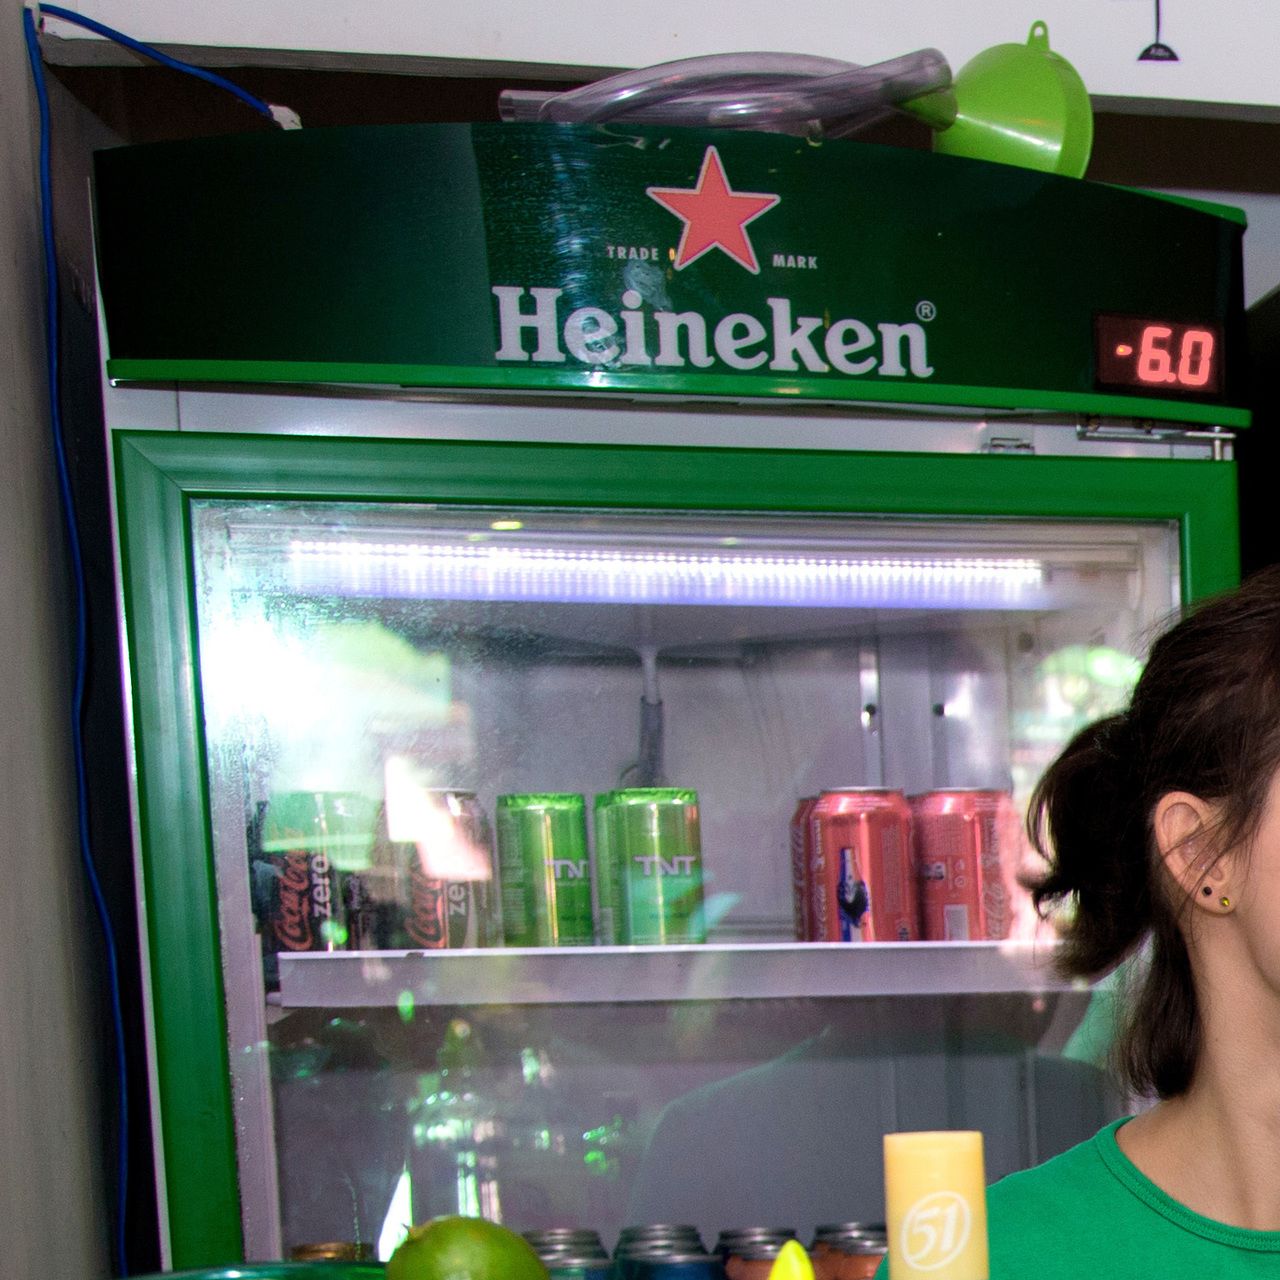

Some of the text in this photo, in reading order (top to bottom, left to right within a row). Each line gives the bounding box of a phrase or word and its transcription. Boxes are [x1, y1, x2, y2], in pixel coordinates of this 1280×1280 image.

[607, 246, 818, 270] TRADE MARK
[492, 286, 934, 379] Heineken
[310, 855, 331, 917] zero
[634, 856, 696, 876] TNT
[908, 1200, 964, 1266] 51
